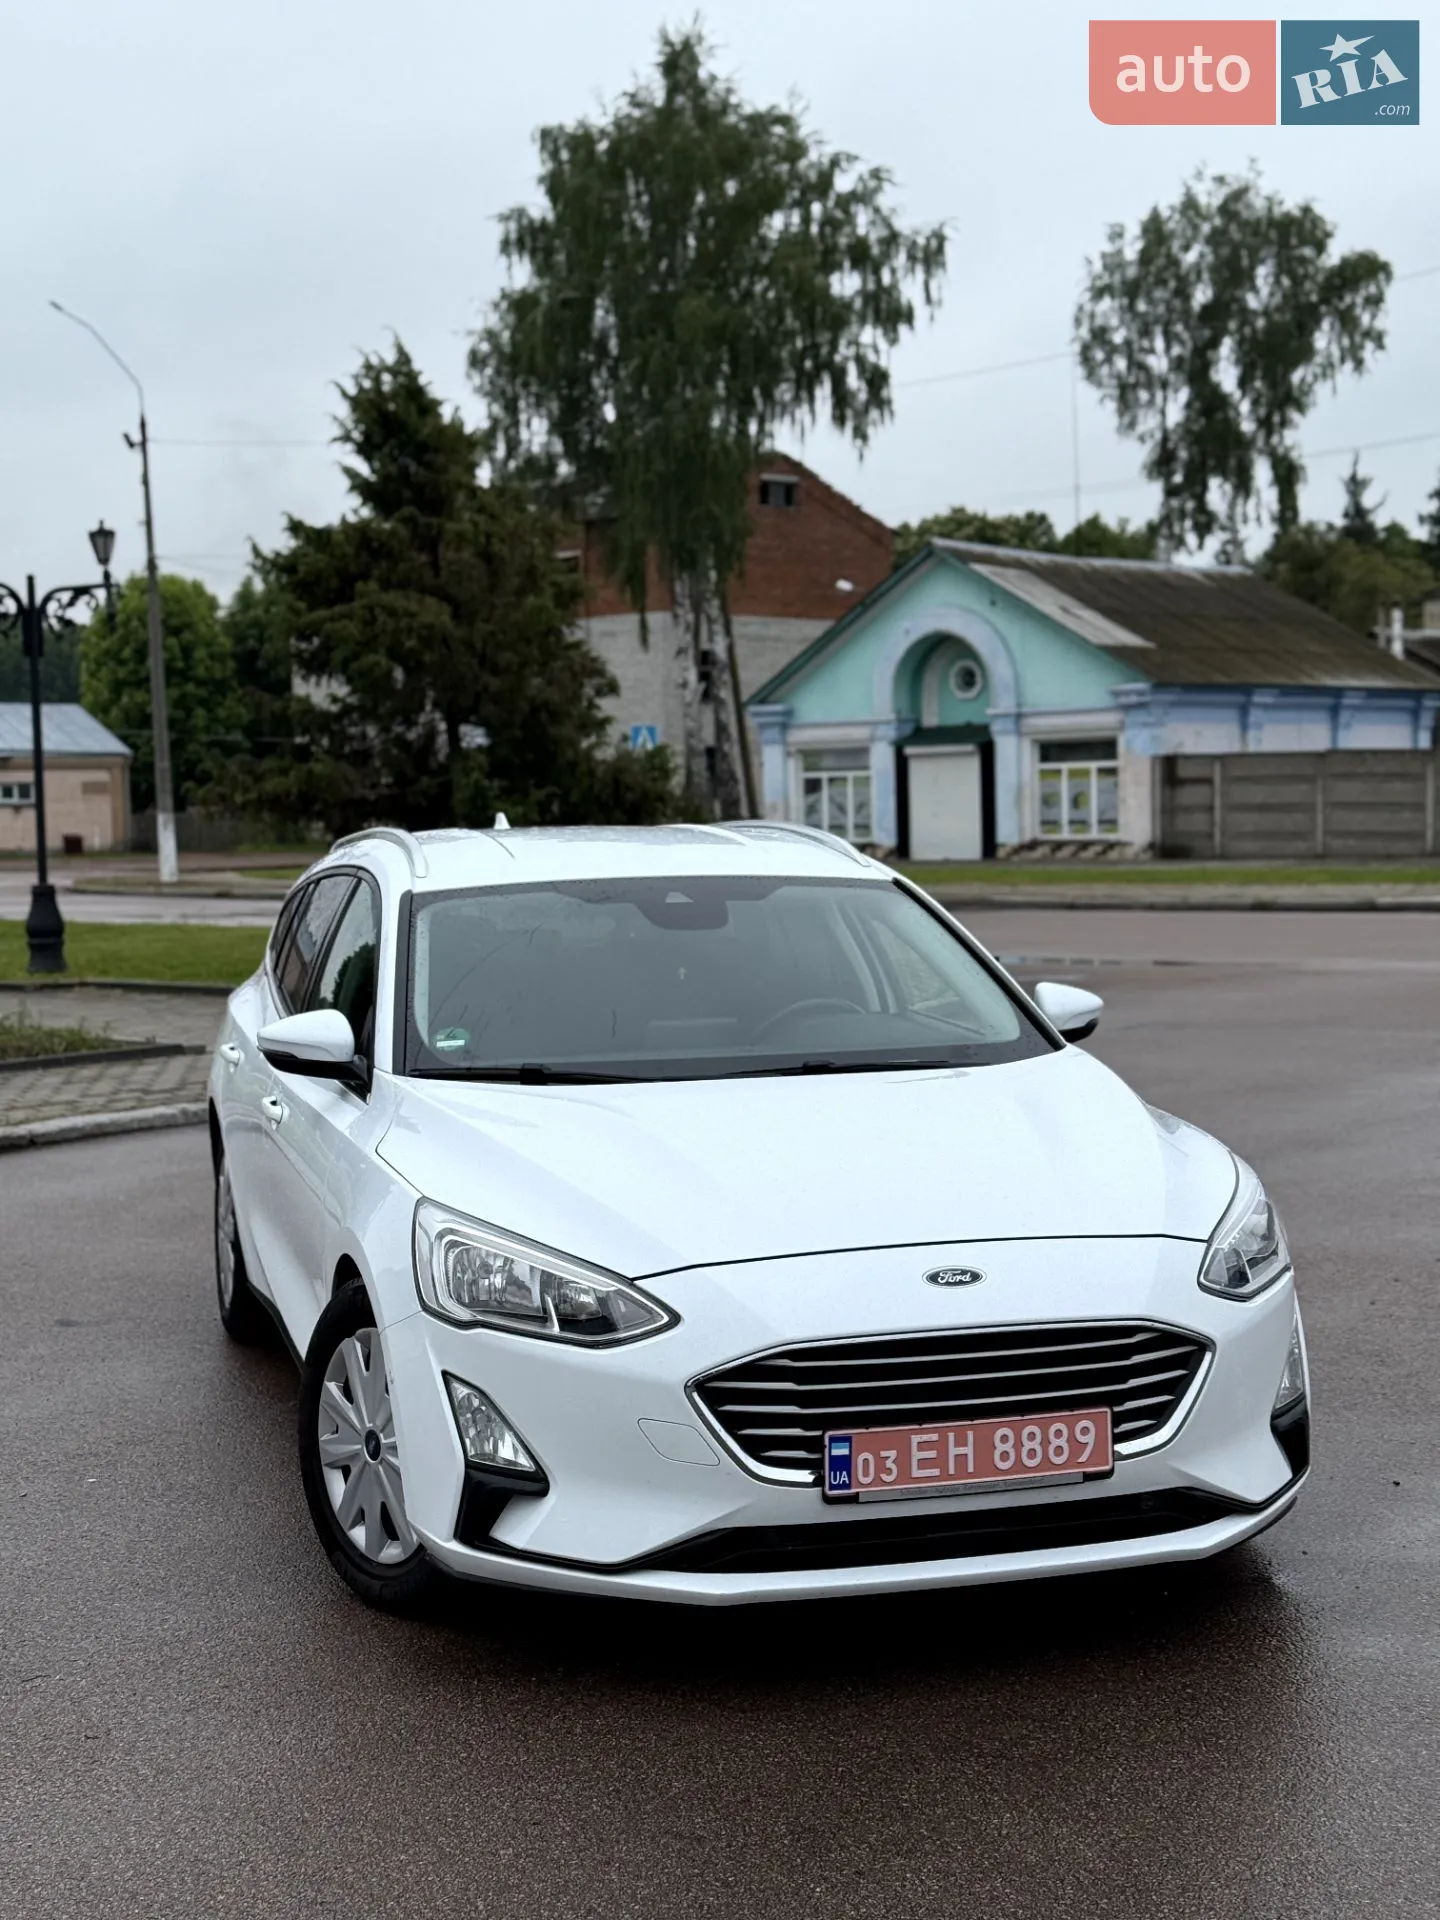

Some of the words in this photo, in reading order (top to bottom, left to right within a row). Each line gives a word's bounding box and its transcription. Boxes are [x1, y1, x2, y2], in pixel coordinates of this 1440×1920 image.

[937, 1270, 972, 1284] Ford
[856, 1450, 898, 1485] 03
[910, 1430, 975, 1478] EH
[993, 1419, 1096, 1471] 8889
[830, 1471, 849, 1485] UA
